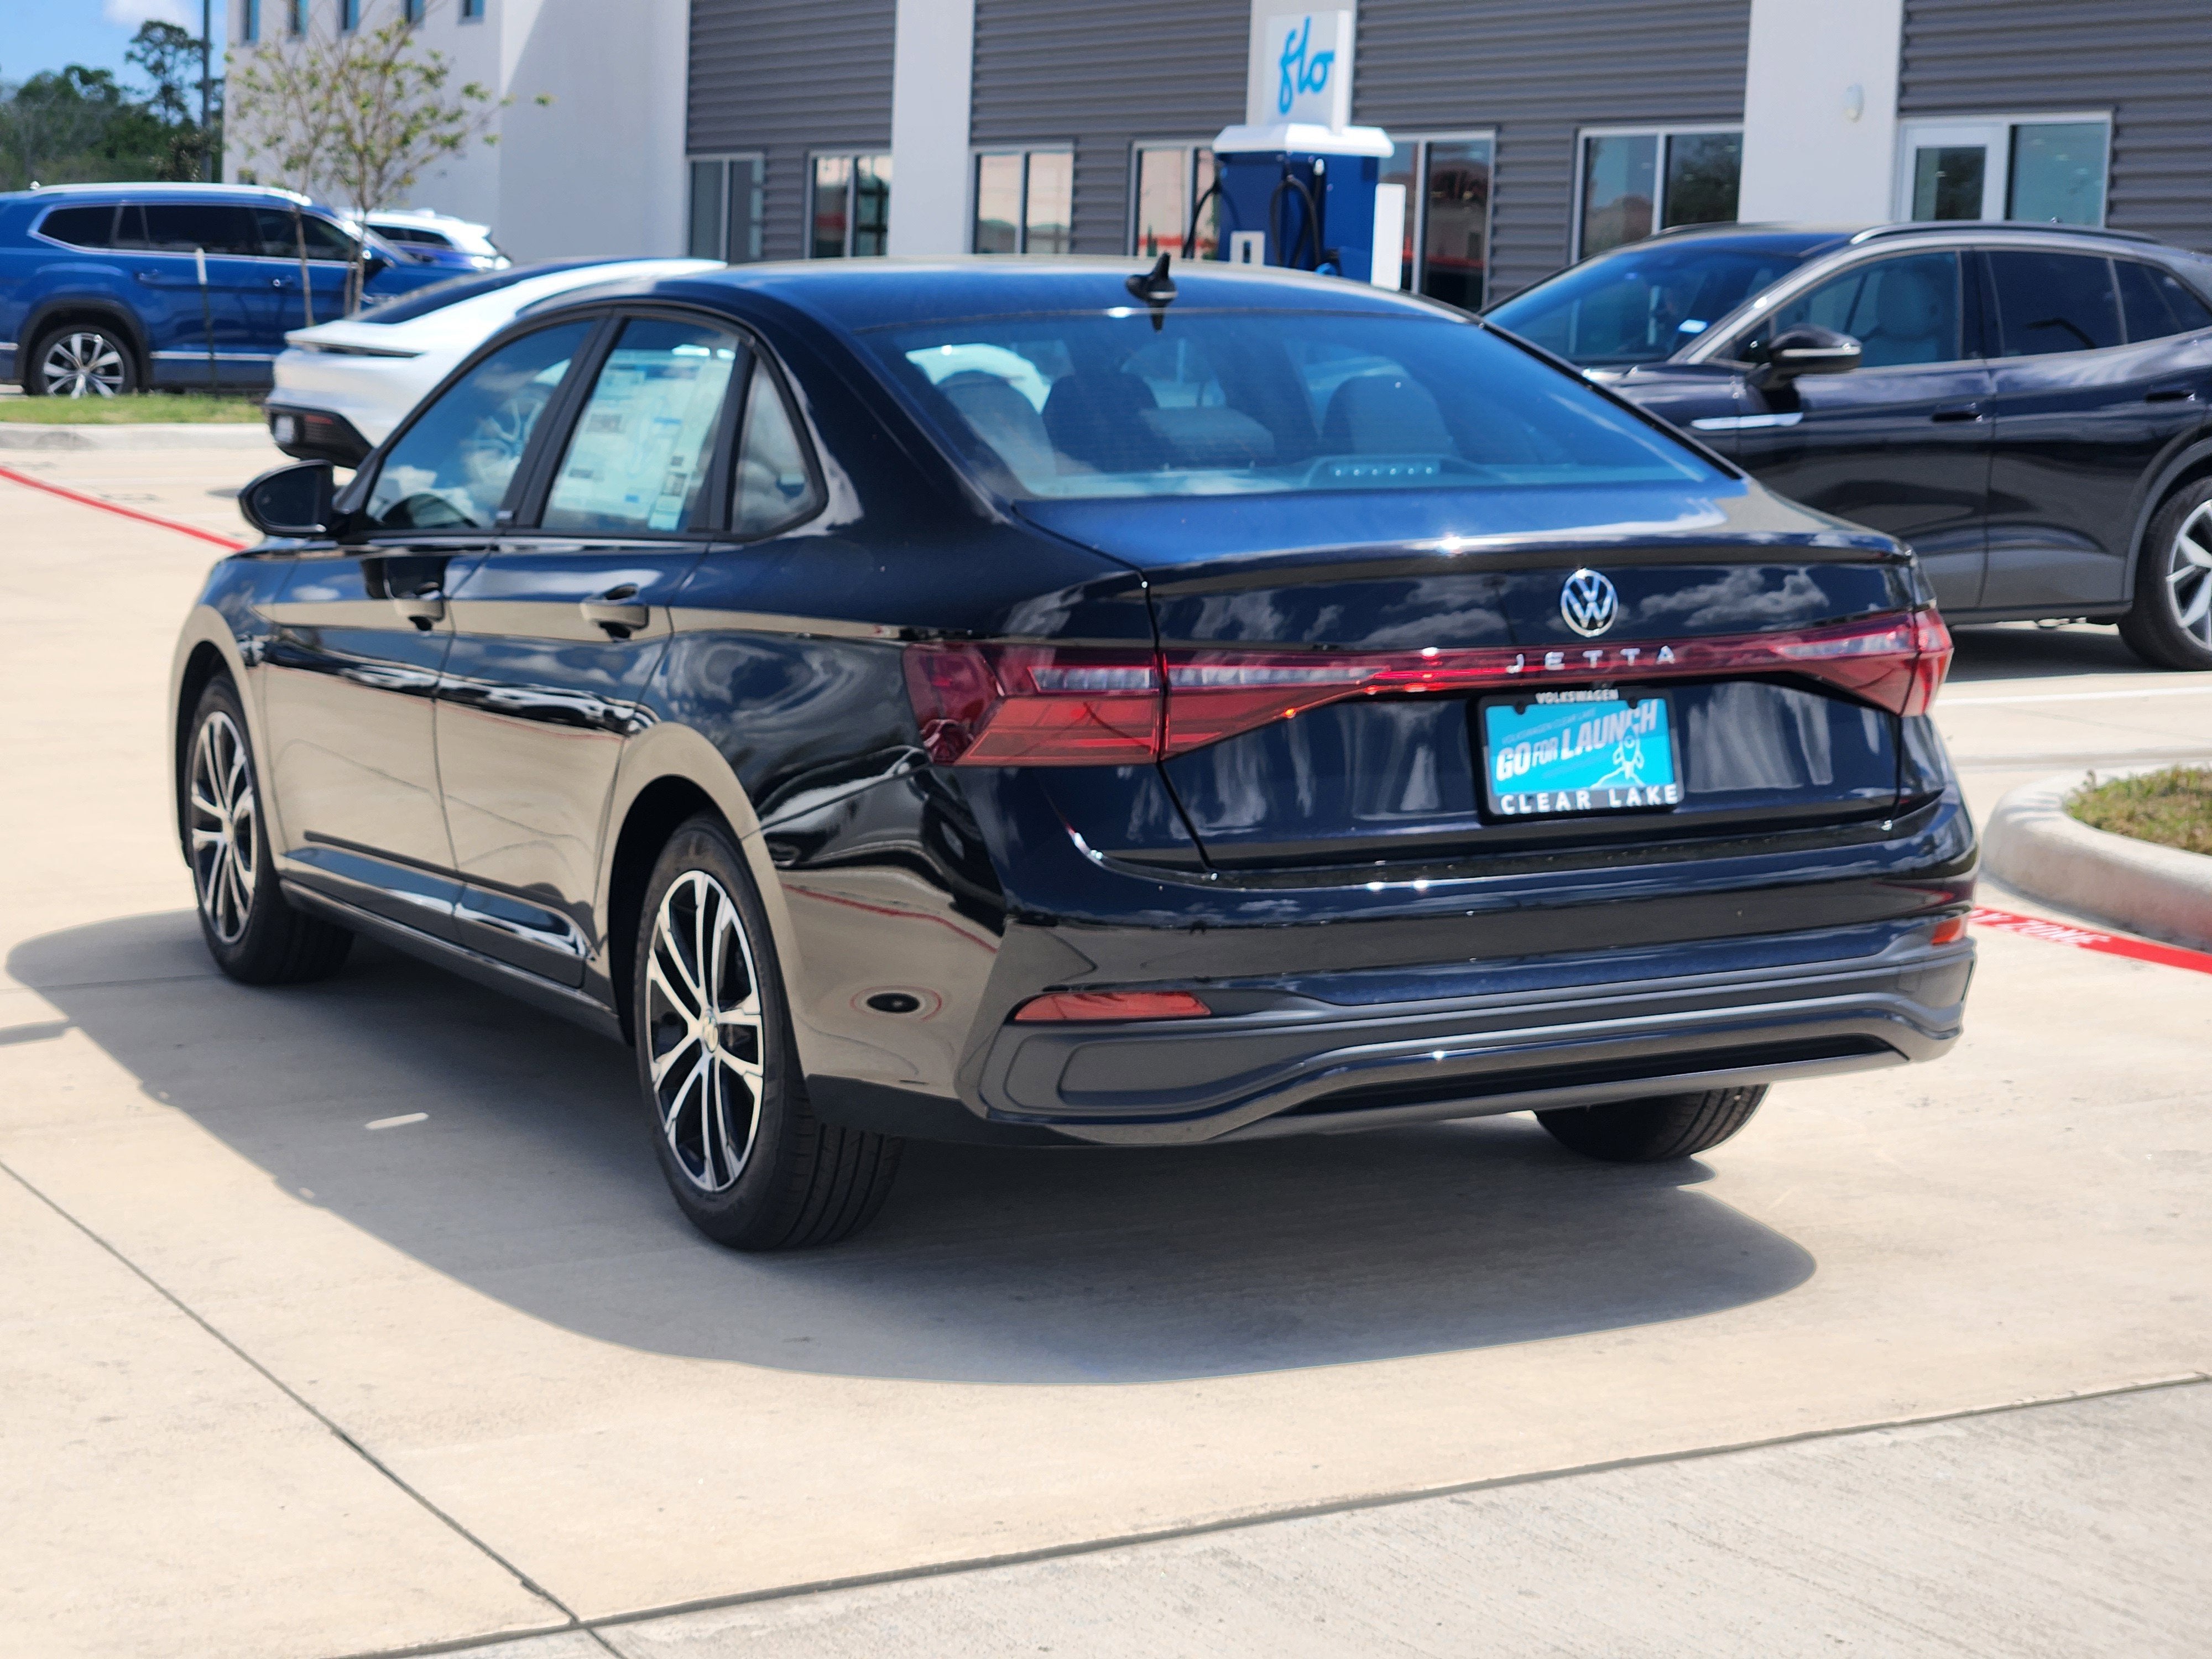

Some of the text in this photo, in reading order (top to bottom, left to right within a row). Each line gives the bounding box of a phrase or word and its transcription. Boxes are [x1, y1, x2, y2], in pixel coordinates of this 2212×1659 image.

[1278, 15, 1334, 114] flo
[1506, 645, 1675, 674] JETTA
[1536, 688, 1619, 704] VOLKSWAGEN
[1496, 742, 1531, 781] GO
[1532, 737, 1558, 767] FOR
[1561, 699, 1657, 760] LAUNCH
[1501, 784, 1678, 815] CLEAR LAKE
